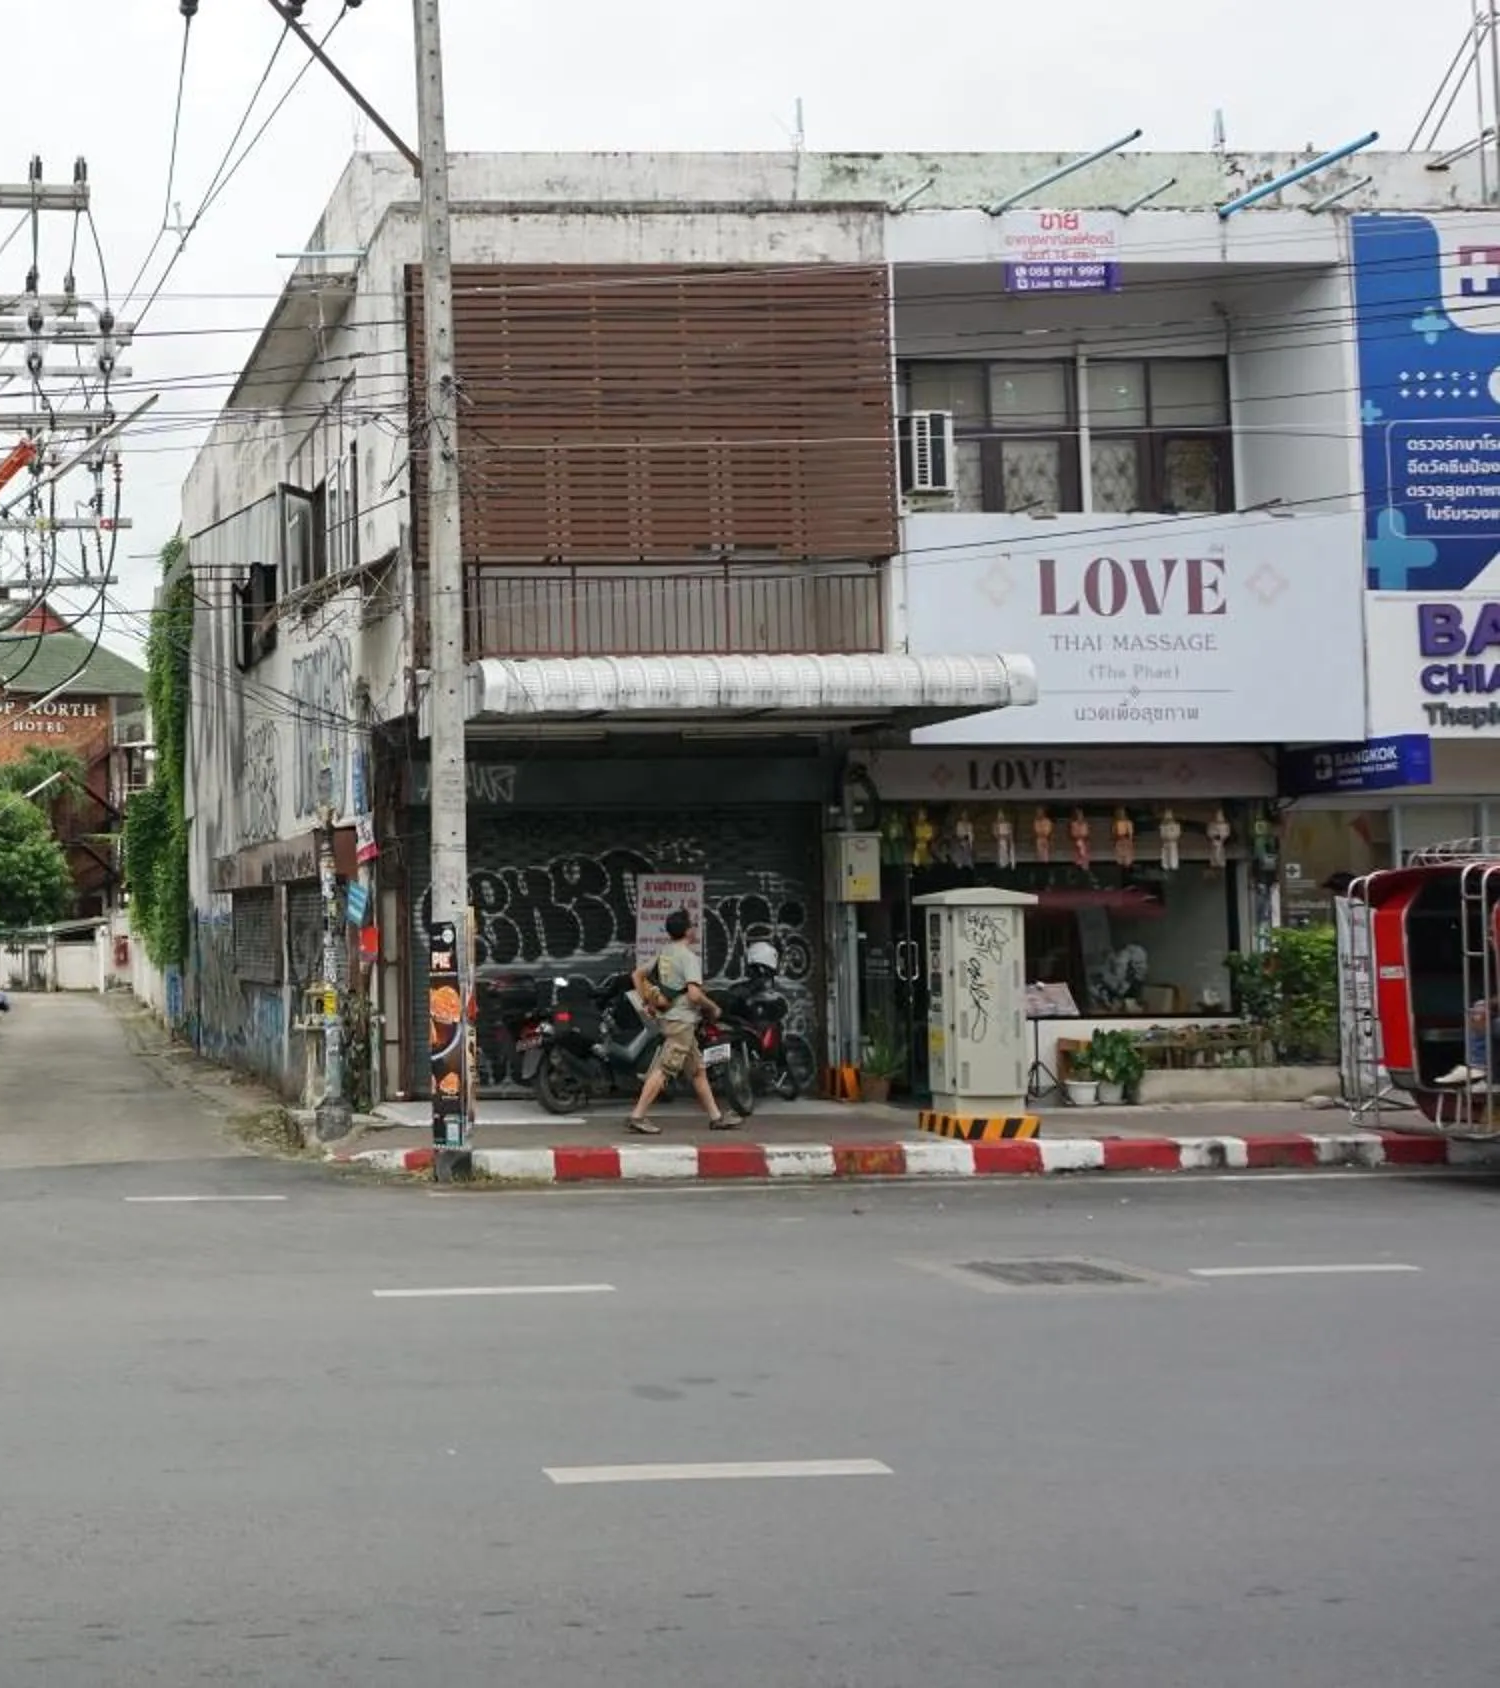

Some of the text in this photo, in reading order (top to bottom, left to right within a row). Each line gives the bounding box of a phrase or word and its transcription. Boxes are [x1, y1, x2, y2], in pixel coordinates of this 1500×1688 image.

[1406, 433, 1500, 451] ตรวจรักษาโร
[1037, 557, 1227, 617] LOVE
[1050, 632, 1218, 651] THAI MASSAGE
[13, 721, 65, 733] HOTEL
[967, 758, 1068, 791] LOVE
